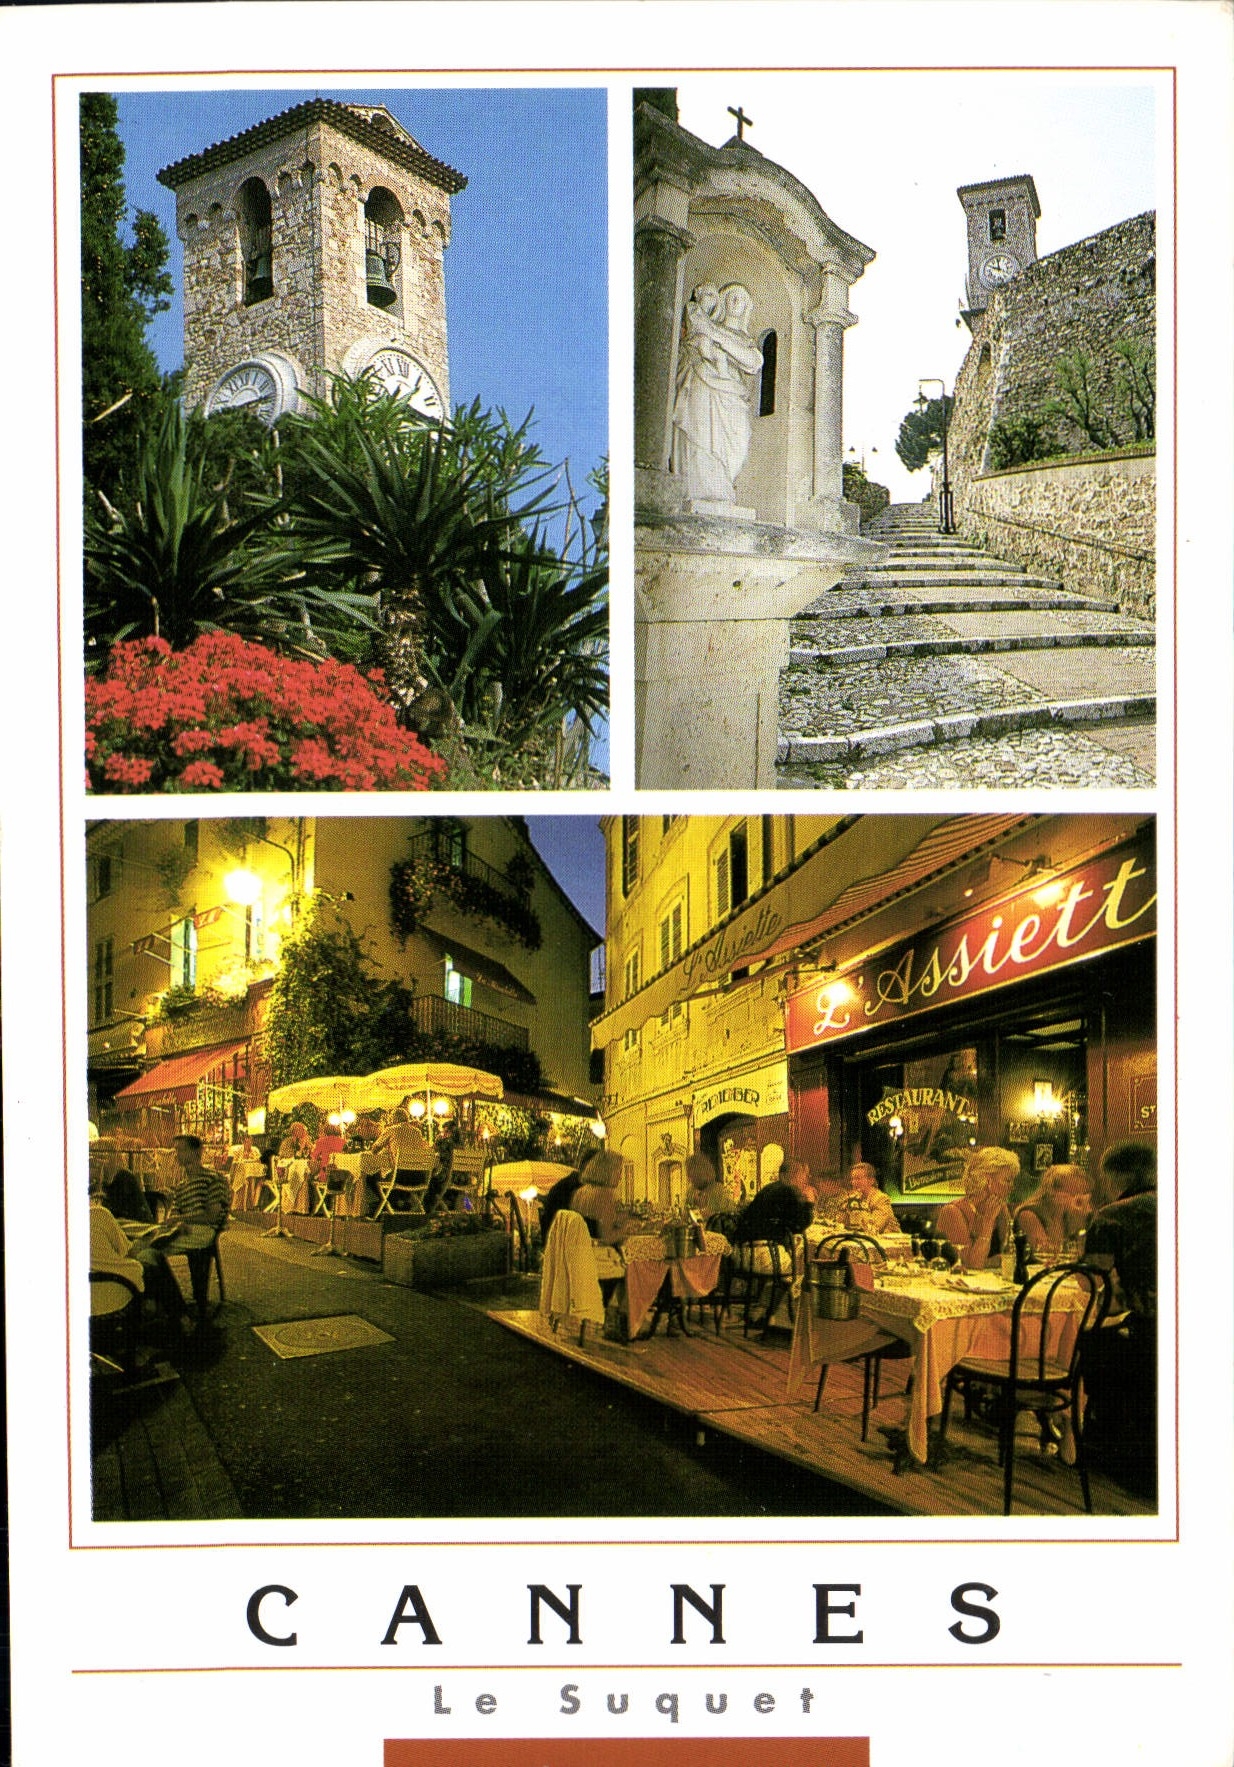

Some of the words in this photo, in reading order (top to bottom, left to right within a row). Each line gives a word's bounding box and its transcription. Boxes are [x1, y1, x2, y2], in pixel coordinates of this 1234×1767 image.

[867, 1087, 970, 1127] RESTAURANT
[246, 1583, 1001, 1648] CANNES
[434, 1685, 498, 1716] Le
[560, 1685, 817, 1724] Suquet
